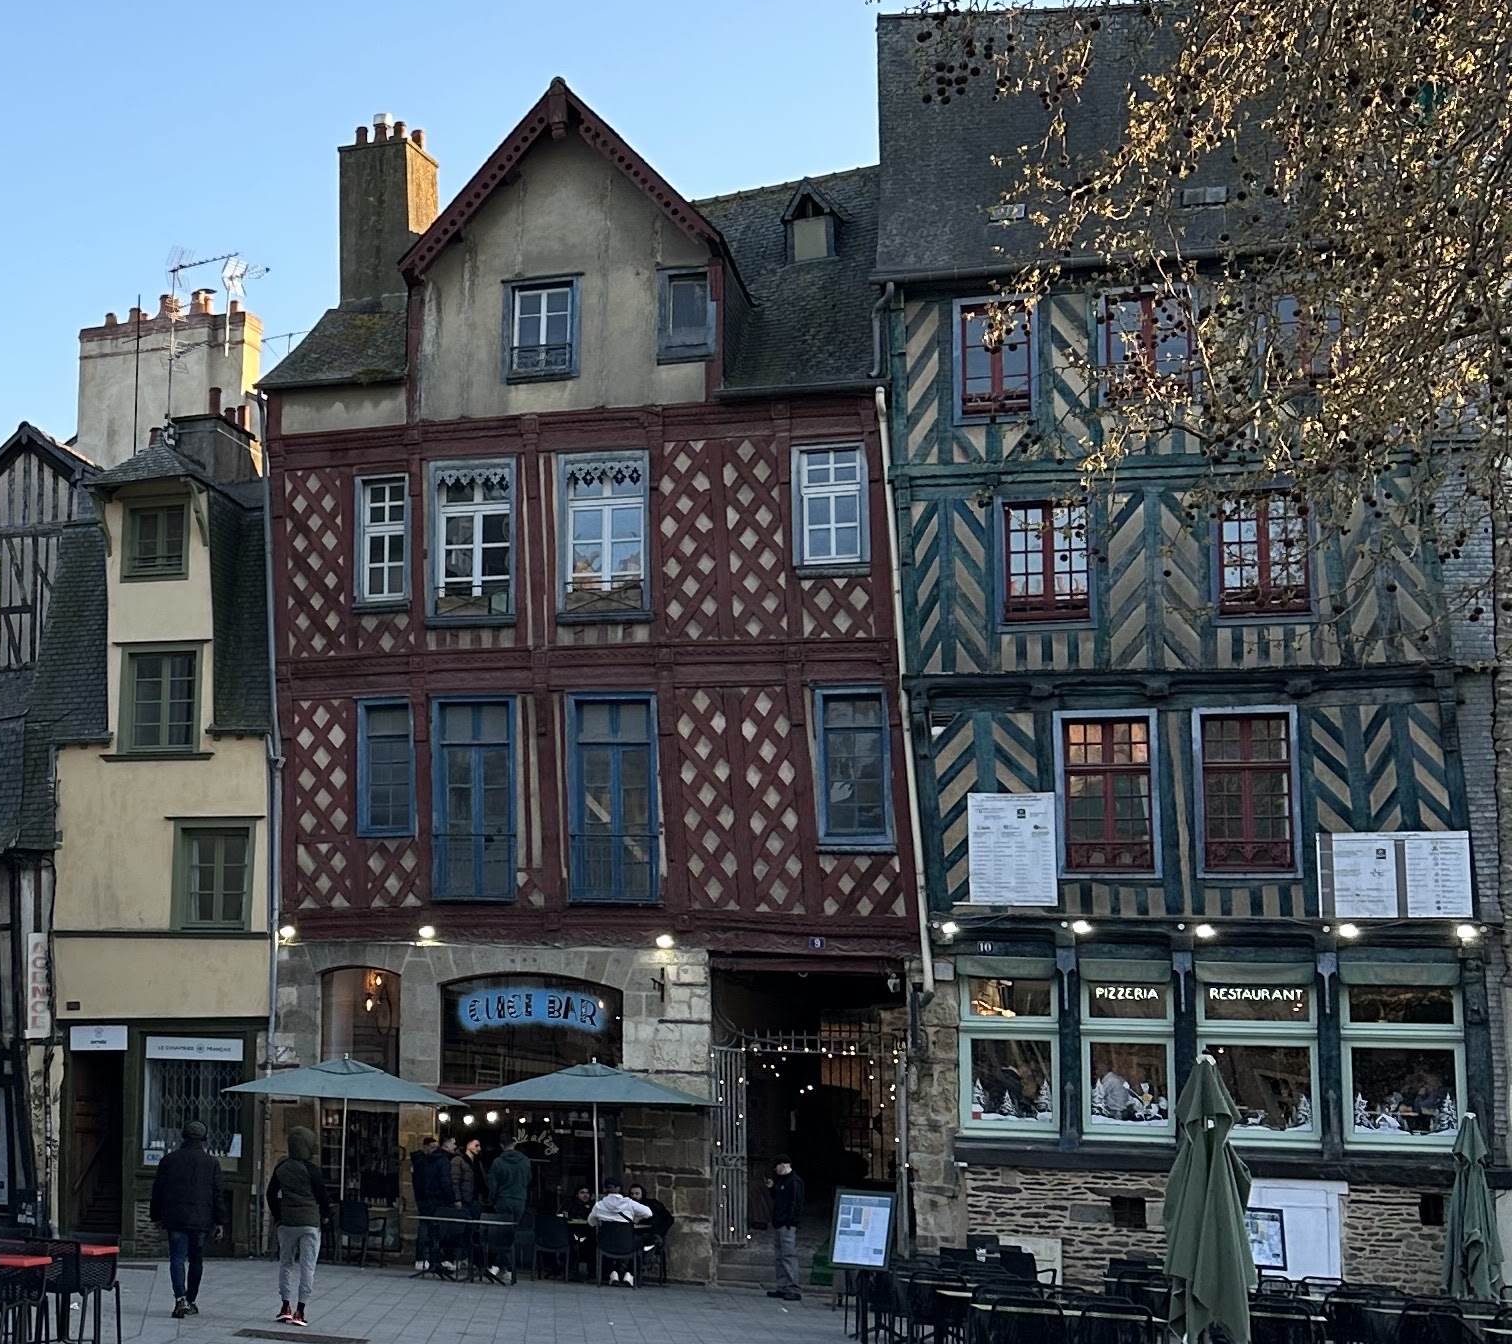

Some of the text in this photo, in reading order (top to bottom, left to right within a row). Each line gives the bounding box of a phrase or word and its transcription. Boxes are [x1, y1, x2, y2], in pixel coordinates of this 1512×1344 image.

[814, 938, 820, 948] 9
[980, 942, 992, 952] 10
[1096, 986, 1303, 1001] PIZZERIA RESTAURANT
[468, 994, 596, 1026] CUCI BAR
